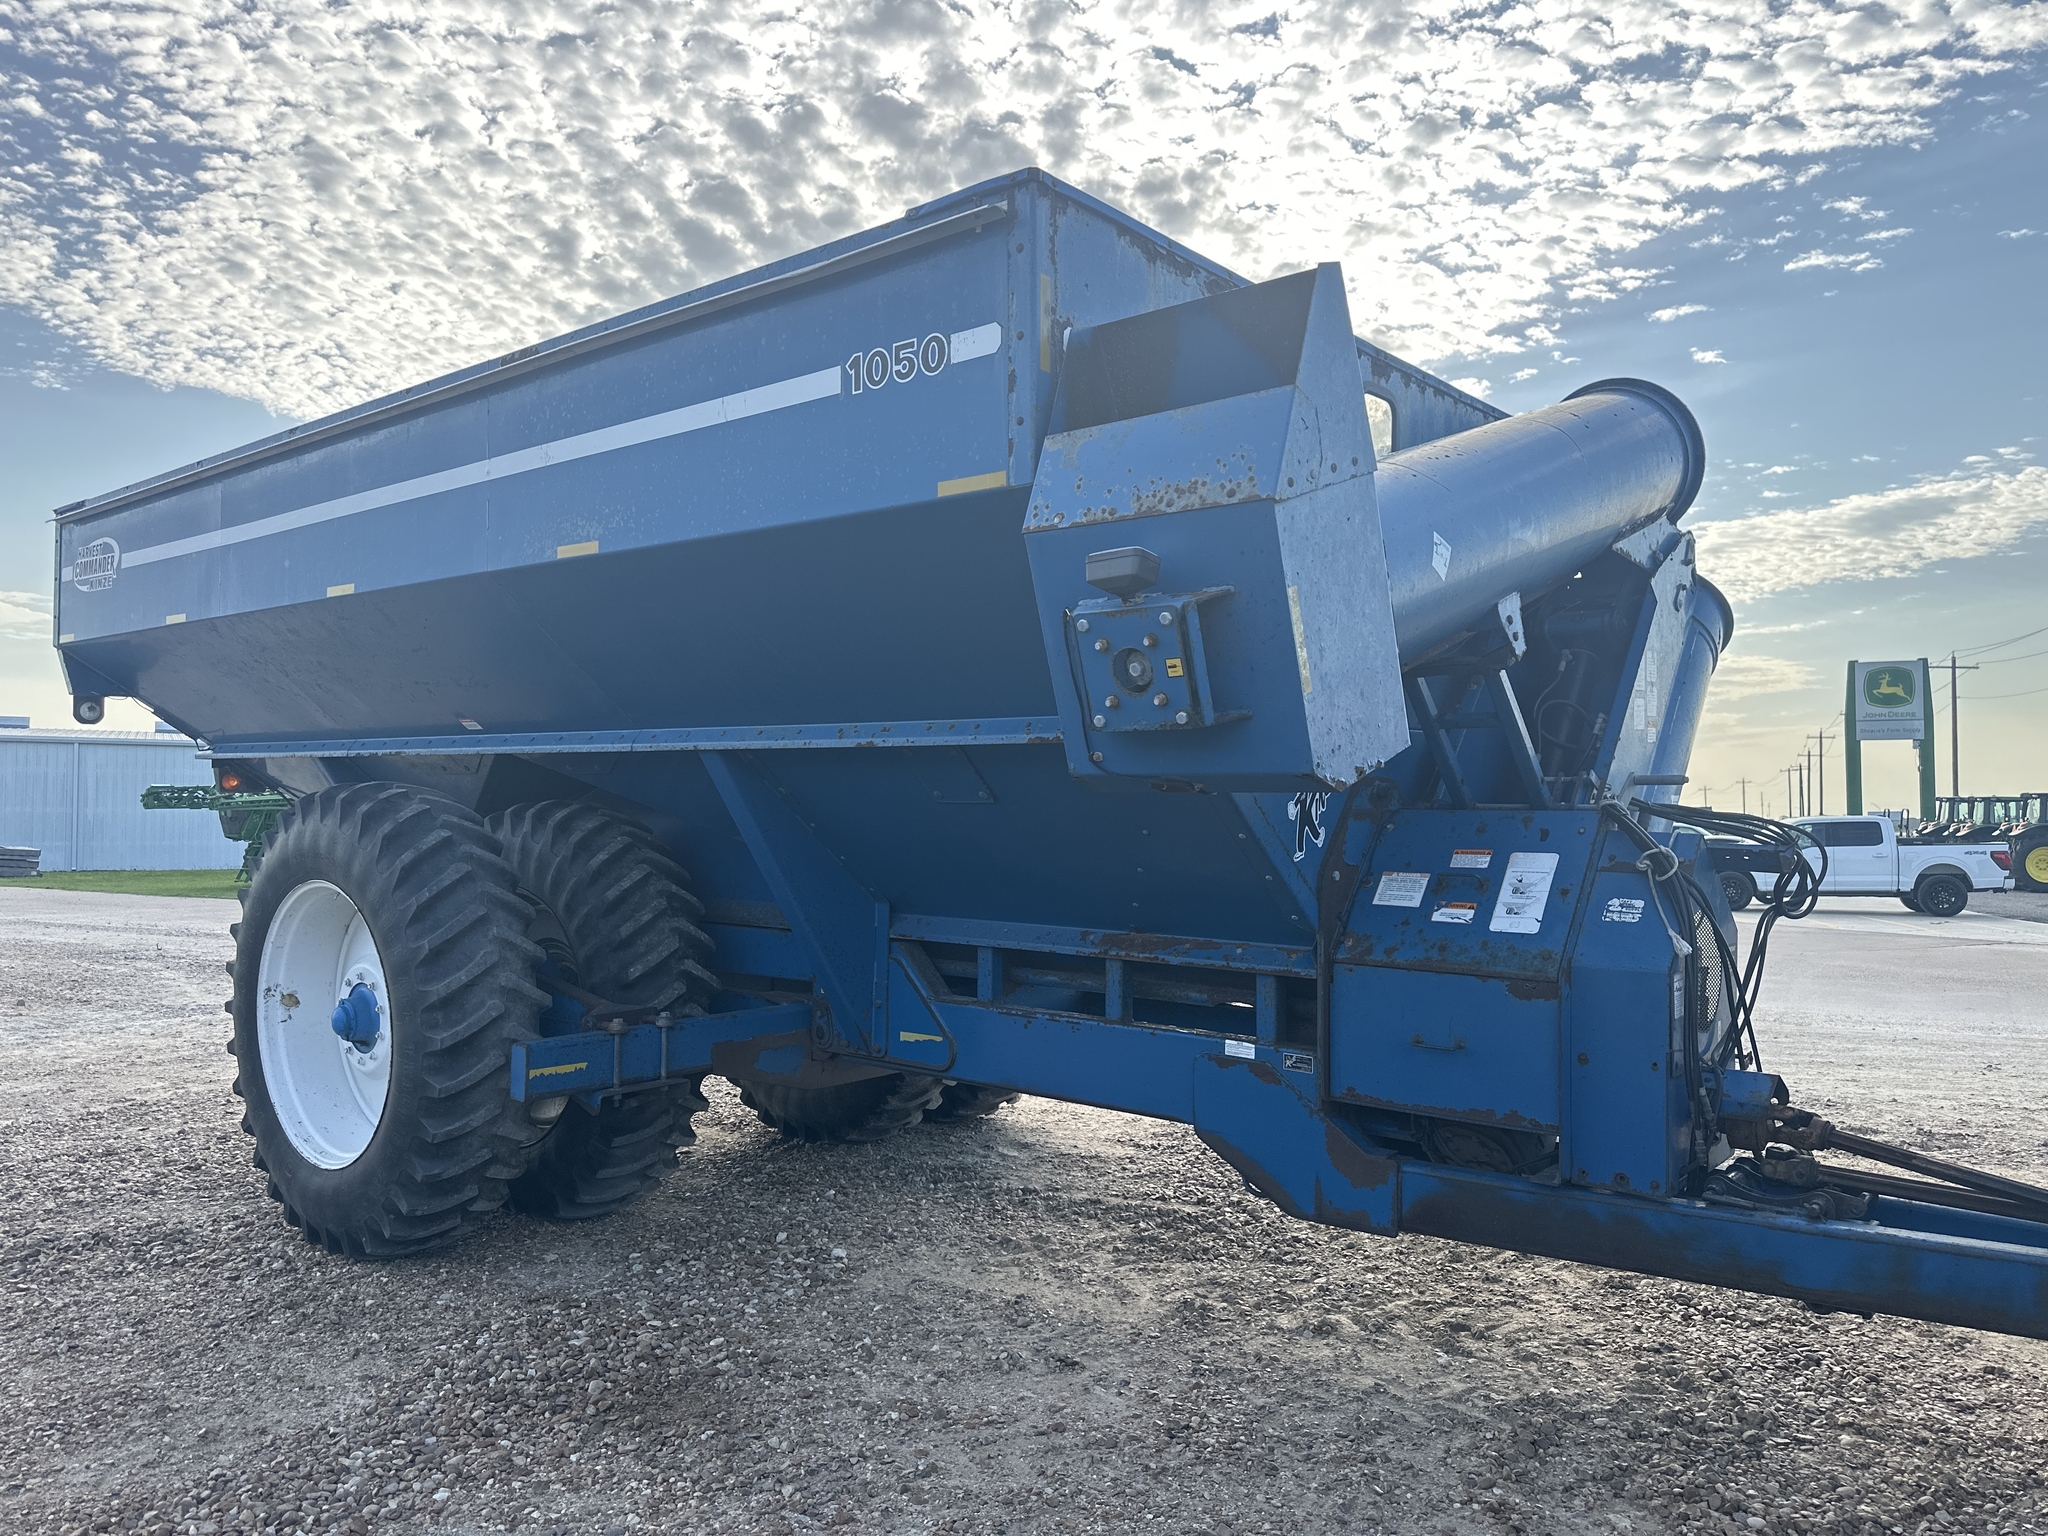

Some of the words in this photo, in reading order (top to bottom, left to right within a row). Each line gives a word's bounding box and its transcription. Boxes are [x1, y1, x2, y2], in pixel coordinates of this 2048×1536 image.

[846, 332, 948, 395] 1050
[78, 543, 103, 559] HARVEST
[74, 553, 116, 580] COMMANDER
[89, 576, 112, 591] KINZE
[1887, 710, 1916, 718] DEERE
